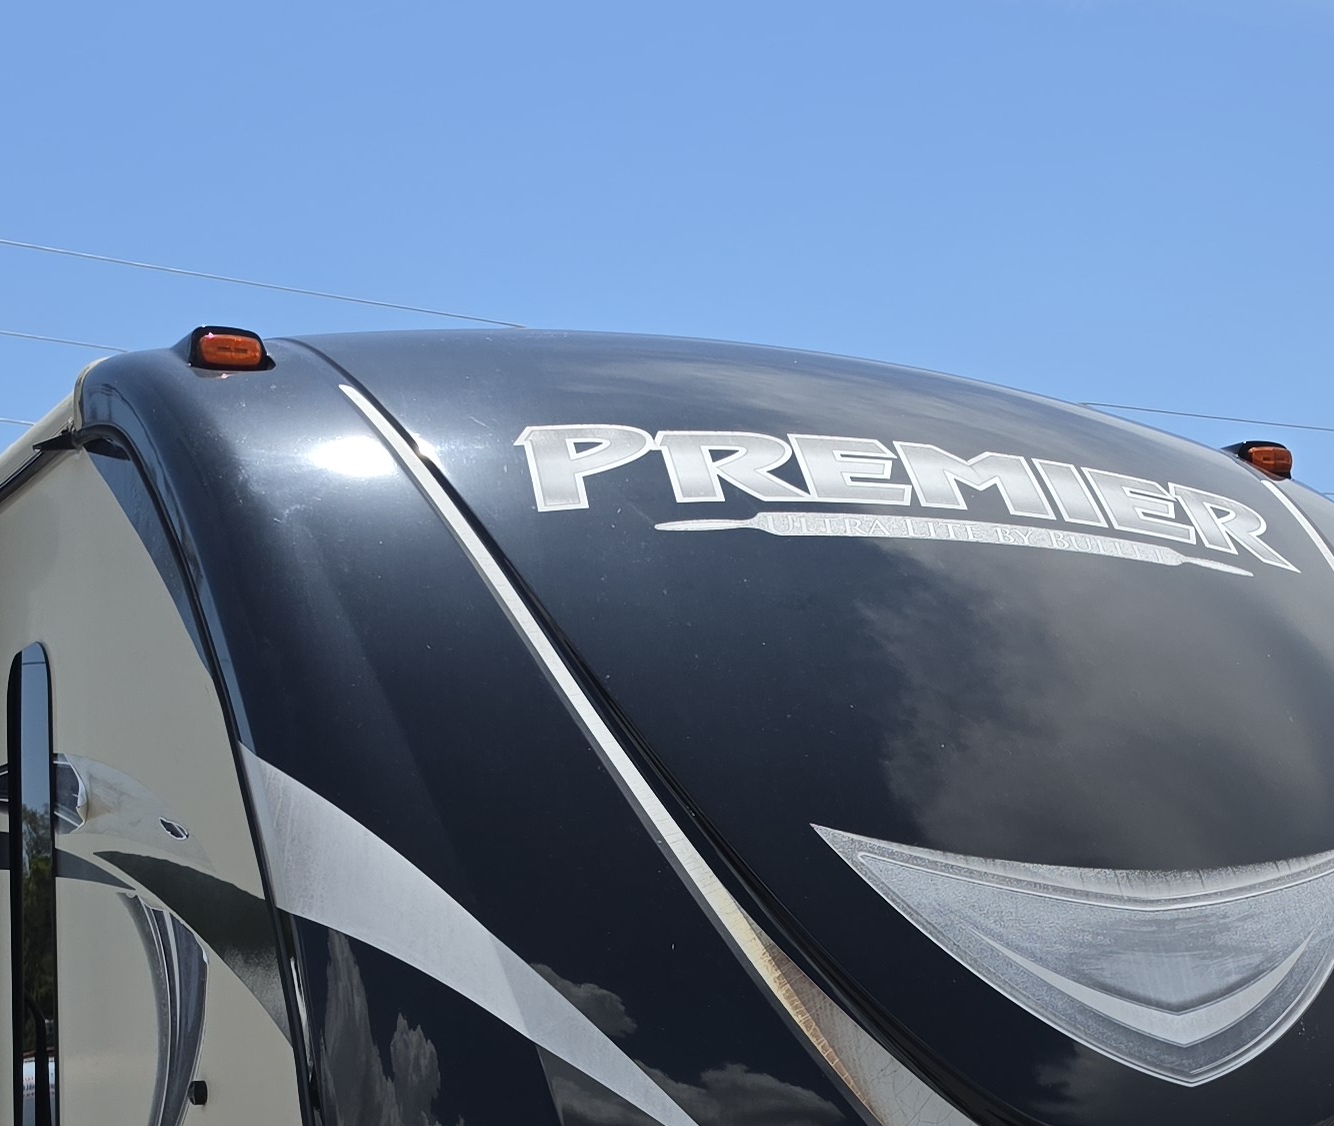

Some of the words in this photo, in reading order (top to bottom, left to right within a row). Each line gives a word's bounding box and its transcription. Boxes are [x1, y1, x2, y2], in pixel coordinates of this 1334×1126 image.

[512, 424, 1302, 574] PREMIER
[766, 513, 892, 536] ULTRA
[905, 517, 985, 543] LITE
[994, 526, 1039, 547] BY
